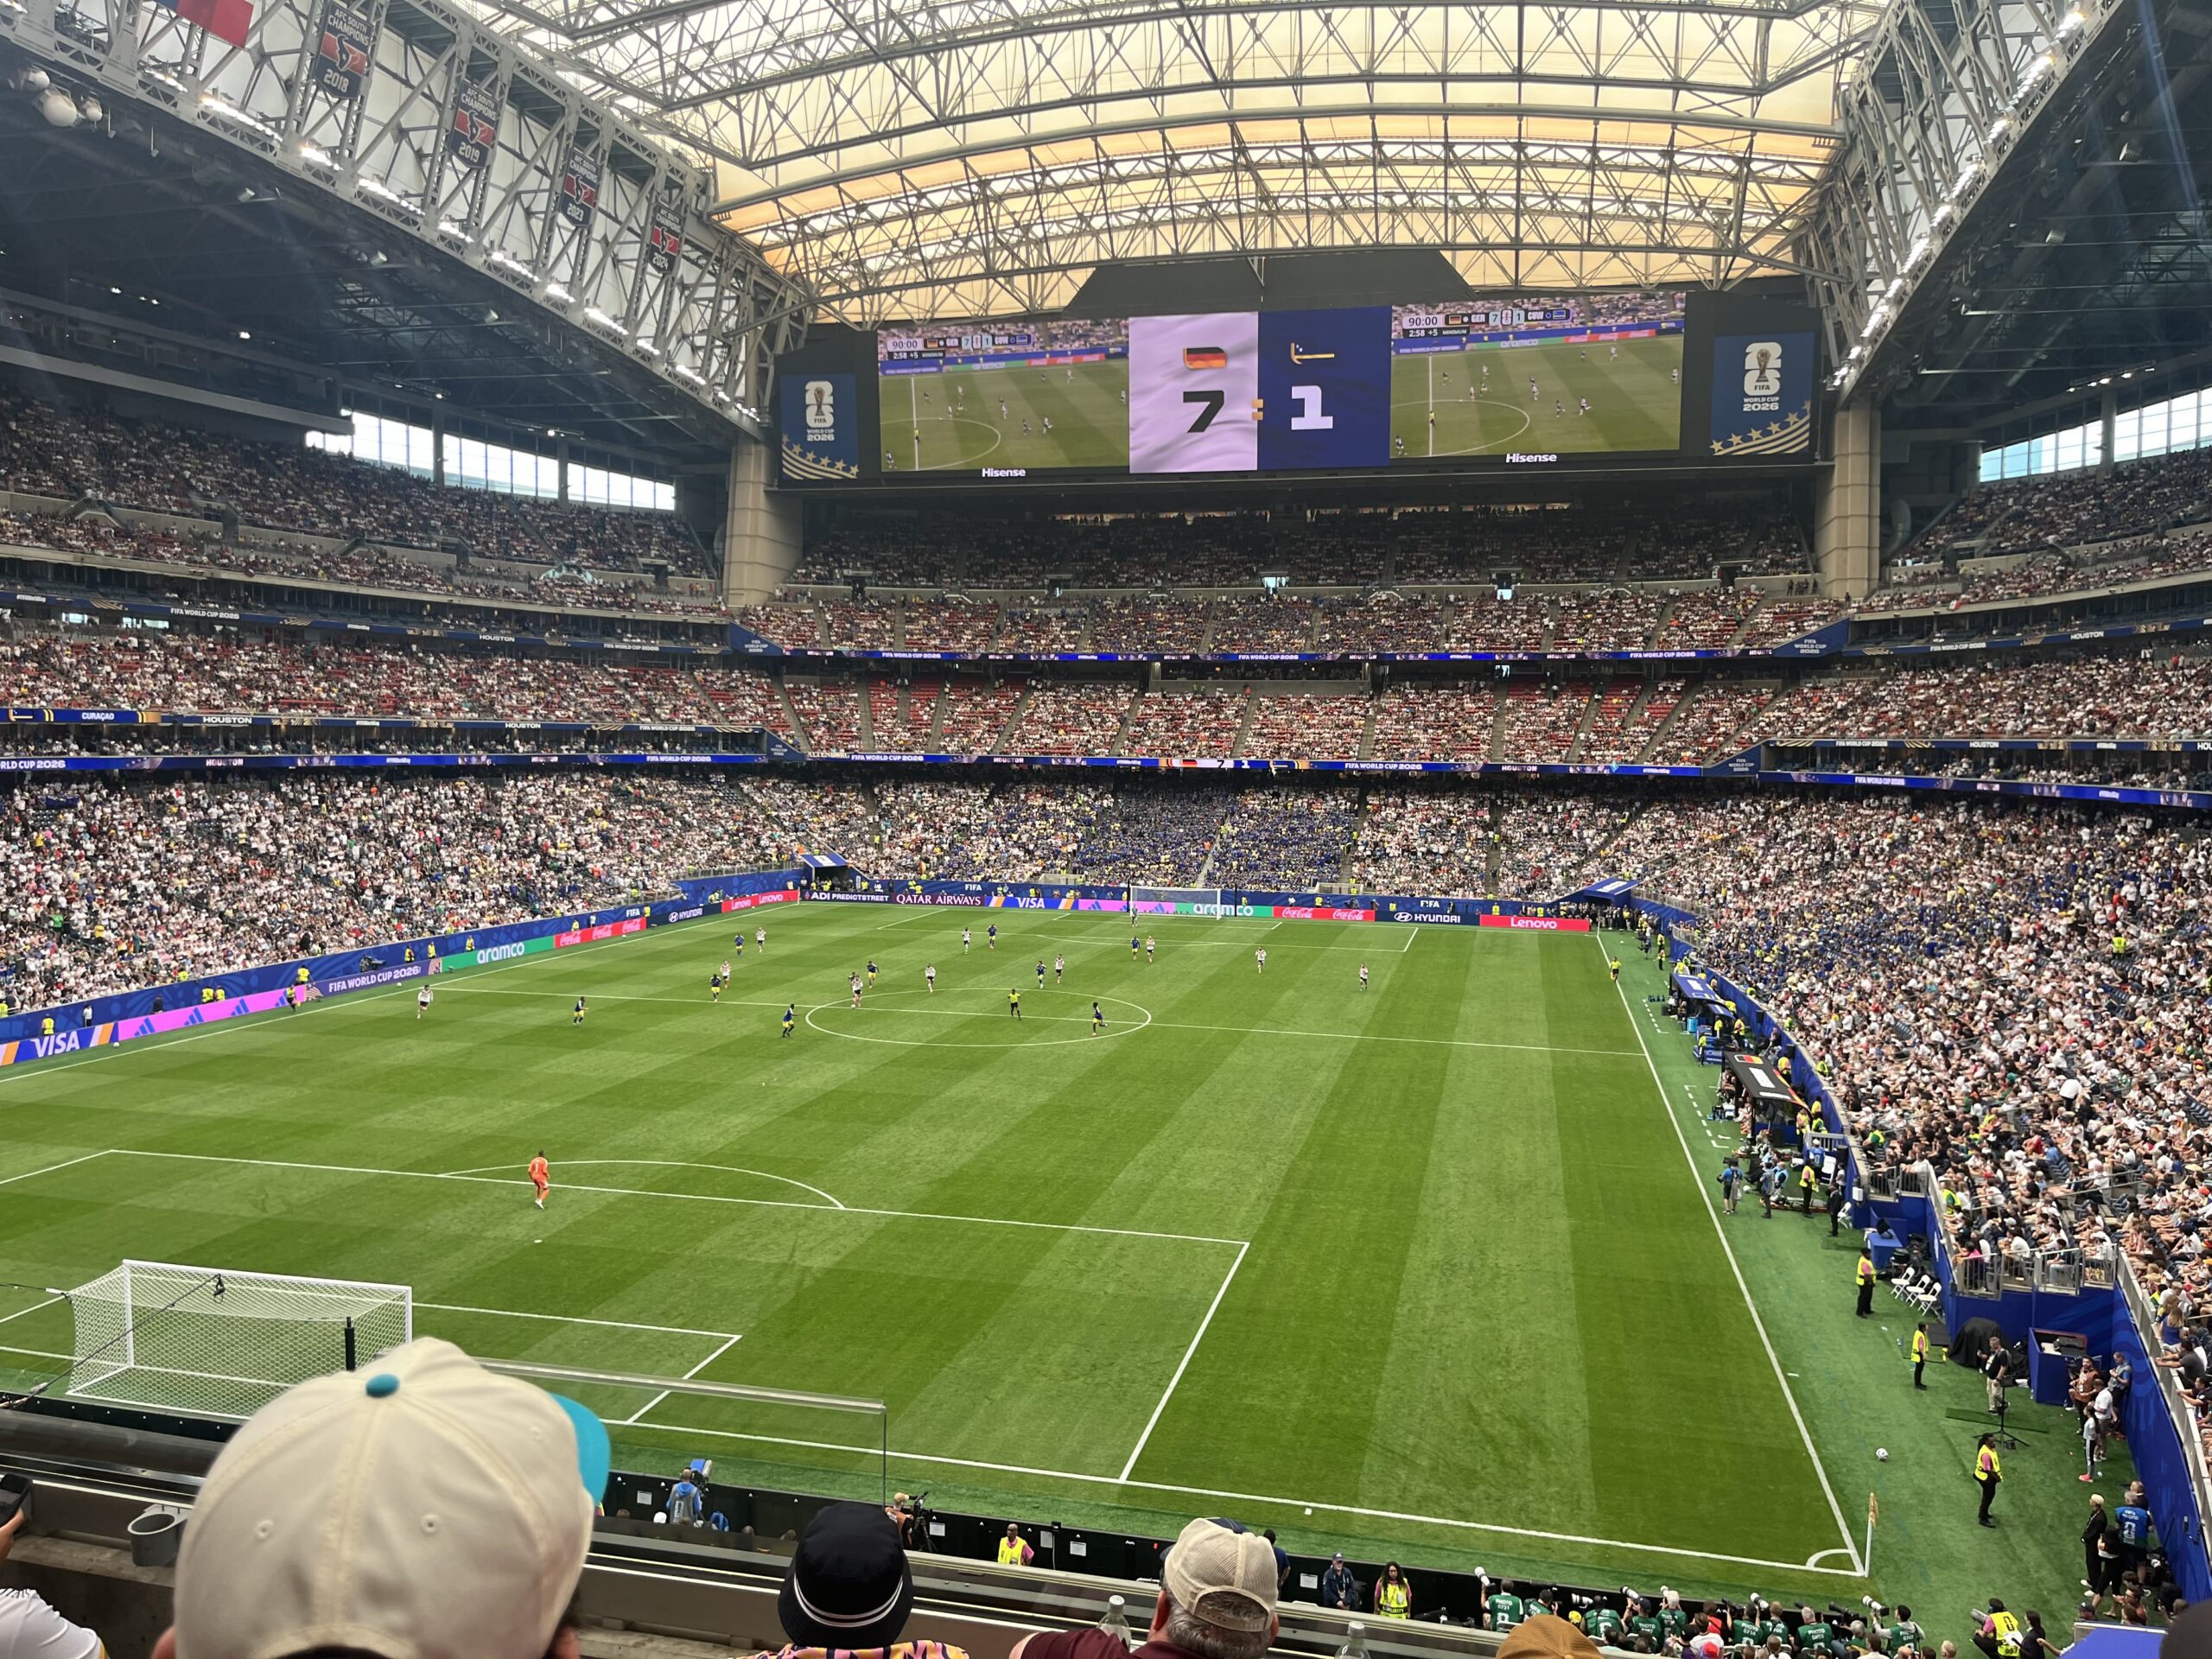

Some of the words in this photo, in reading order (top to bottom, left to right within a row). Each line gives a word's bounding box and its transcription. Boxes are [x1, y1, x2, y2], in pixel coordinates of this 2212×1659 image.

[334, 9, 346, 22] AFC
[347, 17, 367, 33] SOUTH
[327, 15, 370, 46] CHAMPIONS
[323, 68, 349, 93] 2018
[467, 87, 478, 99] AFC
[478, 95, 495, 110] SOUTH
[461, 93, 497, 121] CHAMPIONS
[458, 142, 480, 163] 2019
[566, 203, 584, 222] 2023
[1408, 316, 1438, 327] 90:00
[1471, 315, 1485, 323] GER
[1492, 314, 1498, 322] 7
[1528, 311, 1544, 321] CUW
[892, 340, 918, 349] 90:00
[964, 338, 970, 346] 7
[1183, 389, 1224, 434] 7
[1291, 385, 1333, 430] 1
[1743, 403, 1779, 412] 2026
[1505, 453, 1557, 463] Hisense
[982, 467, 1026, 478] Hisense
[184, 608, 206, 617] WORLD
[219, 611, 240, 620] 2026
[2070, 630, 2104, 640] HOUSTON
[81, 711, 115, 721] CURAÇAO
[202, 715, 252, 724] HOUSTON
[0, 760, 17, 769] RLD
[18, 760, 36, 769] CUP
[1217, 760, 1225, 768] 7
[1241, 760, 1250, 768] 1
[759, 893, 784, 904] Lenovo
[831, 893, 889, 902] PREDICTSTREET
[896, 893, 932, 904] QATAR
[935, 895, 982, 906] AIRWAYS
[1017, 897, 1045, 908] VISA
[731, 899, 752, 910] Lenovo
[1420, 899, 1440, 908] FIFA
[626, 908, 640, 918] FIFA
[678, 907, 702, 919] HYUNDAI
[1193, 905, 1255, 916] aramco
[1414, 913, 1461, 924] HYUNDAI
[1510, 917, 1558, 929] Lenovo
[477, 941, 525, 964] aramco
[328, 982, 347, 993] FIFA
[347, 976, 377, 988] WORLD
[377, 971, 393, 982] CUP
[393, 965, 419, 977] 2026
[30, 1031, 80, 1058] VISA
[1741, 1622, 1759, 1632] PHOTO
